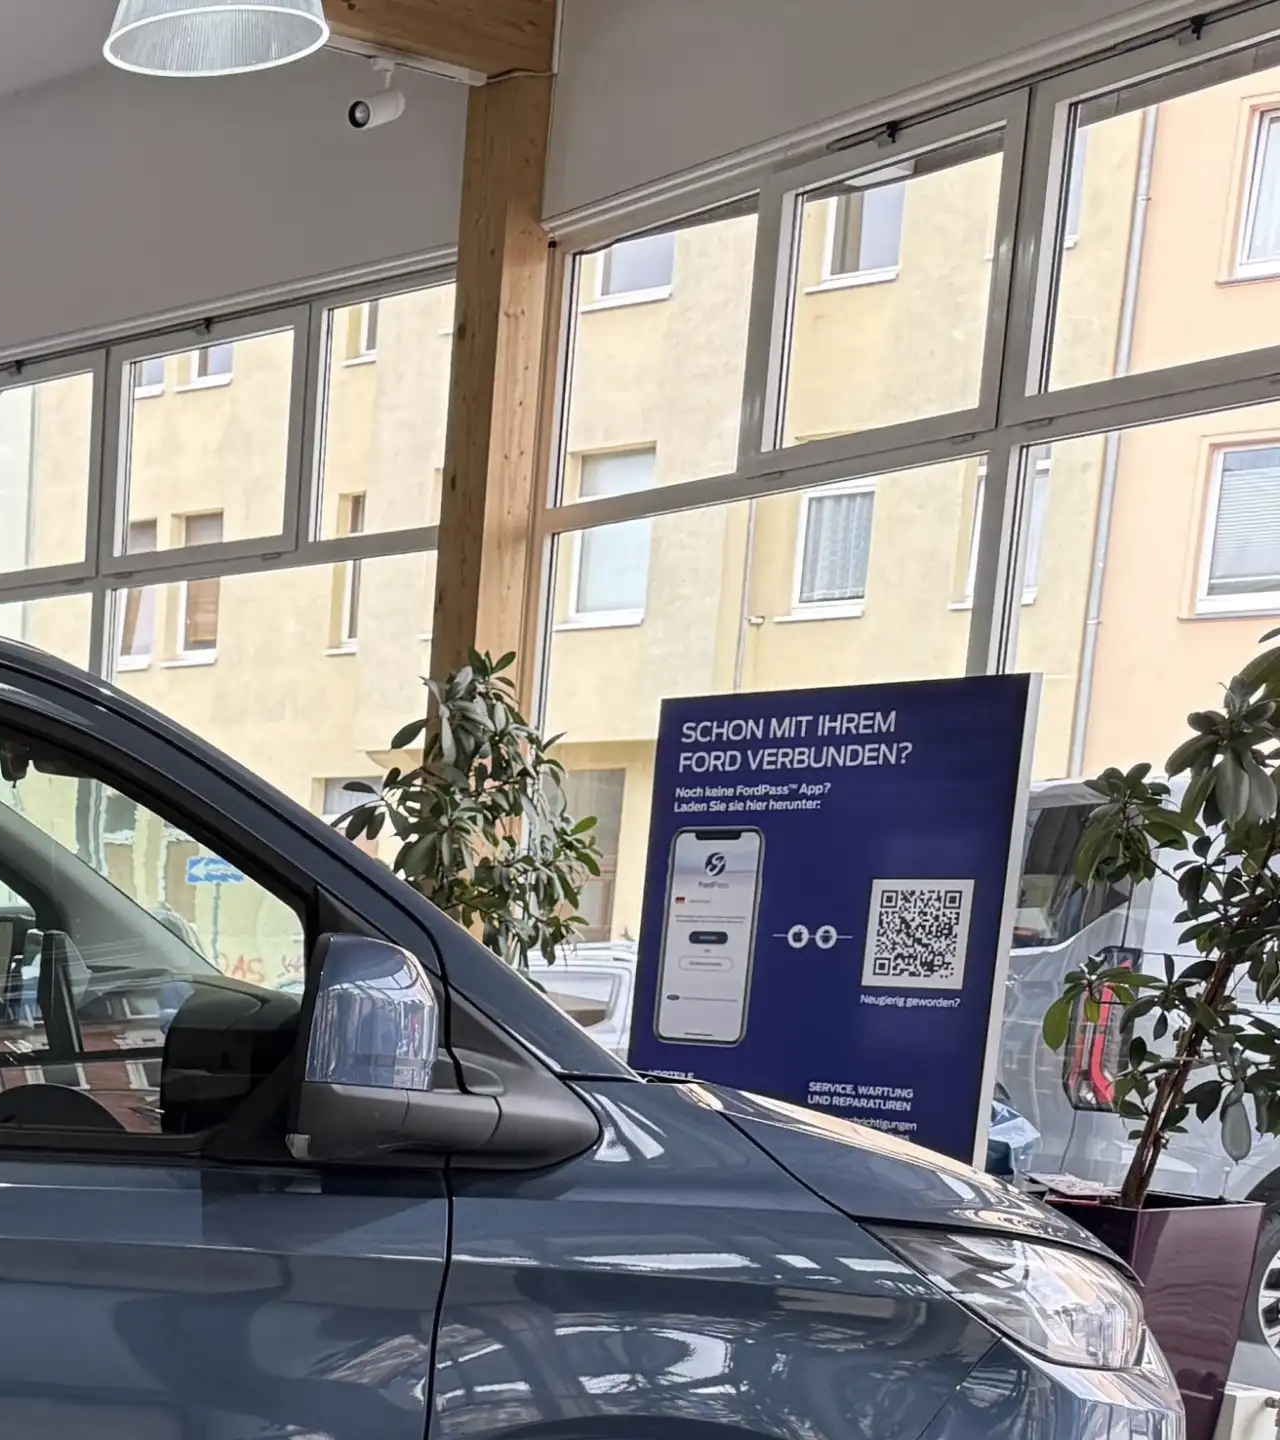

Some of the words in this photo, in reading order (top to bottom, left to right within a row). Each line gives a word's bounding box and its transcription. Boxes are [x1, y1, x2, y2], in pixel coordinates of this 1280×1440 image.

[681, 718, 763, 743] SCHON
[769, 716, 813, 739] MIT
[818, 710, 897, 736] IHREM
[678, 751, 741, 773] FORD
[747, 742, 913, 770] VERBUNDEN?
[675, 786, 703, 798] Noch
[705, 785, 733, 797] keine
[799, 782, 831, 796] App?
[674, 801, 707, 813] Laden
[708, 800, 726, 811] Sie
[727, 800, 744, 811] sie
[745, 799, 767, 810] hier
[769, 798, 821, 810] herunter:
[860, 994, 905, 1007] Neugierig
[906, 997, 961, 1008] geworden?
[808, 1081, 856, 1095] SERVICE,
[857, 1085, 914, 1099] WARTUNG
[807, 1094, 831, 1105] UND
[832, 1095, 912, 1111] REPARATUREN
